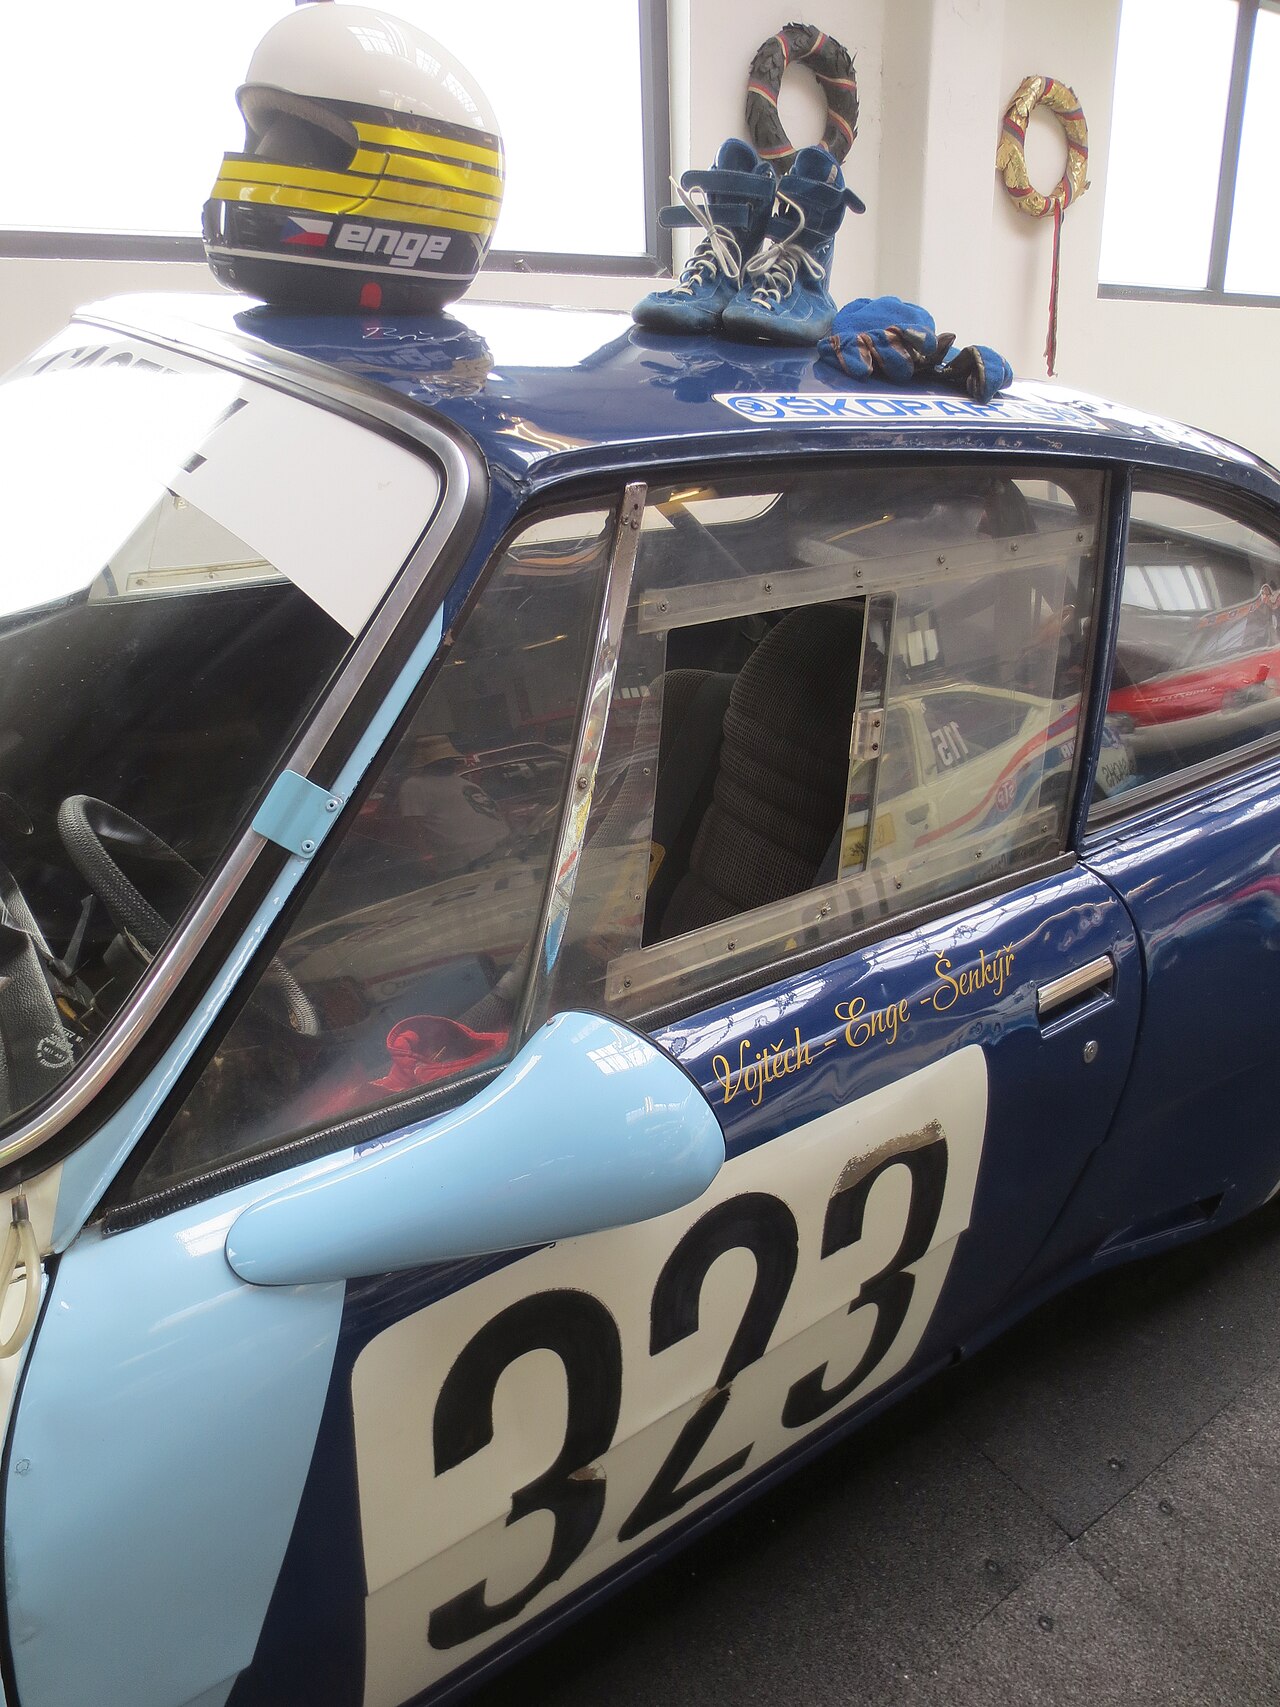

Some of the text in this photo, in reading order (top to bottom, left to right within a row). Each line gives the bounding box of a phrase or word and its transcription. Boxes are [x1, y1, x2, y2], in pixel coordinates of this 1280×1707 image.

[334, 223, 452, 267] enge
[712, 1027, 813, 1106] Vojtěch
[835, 997, 910, 1048] Enge
[427, 1118, 949, 1650] 323
